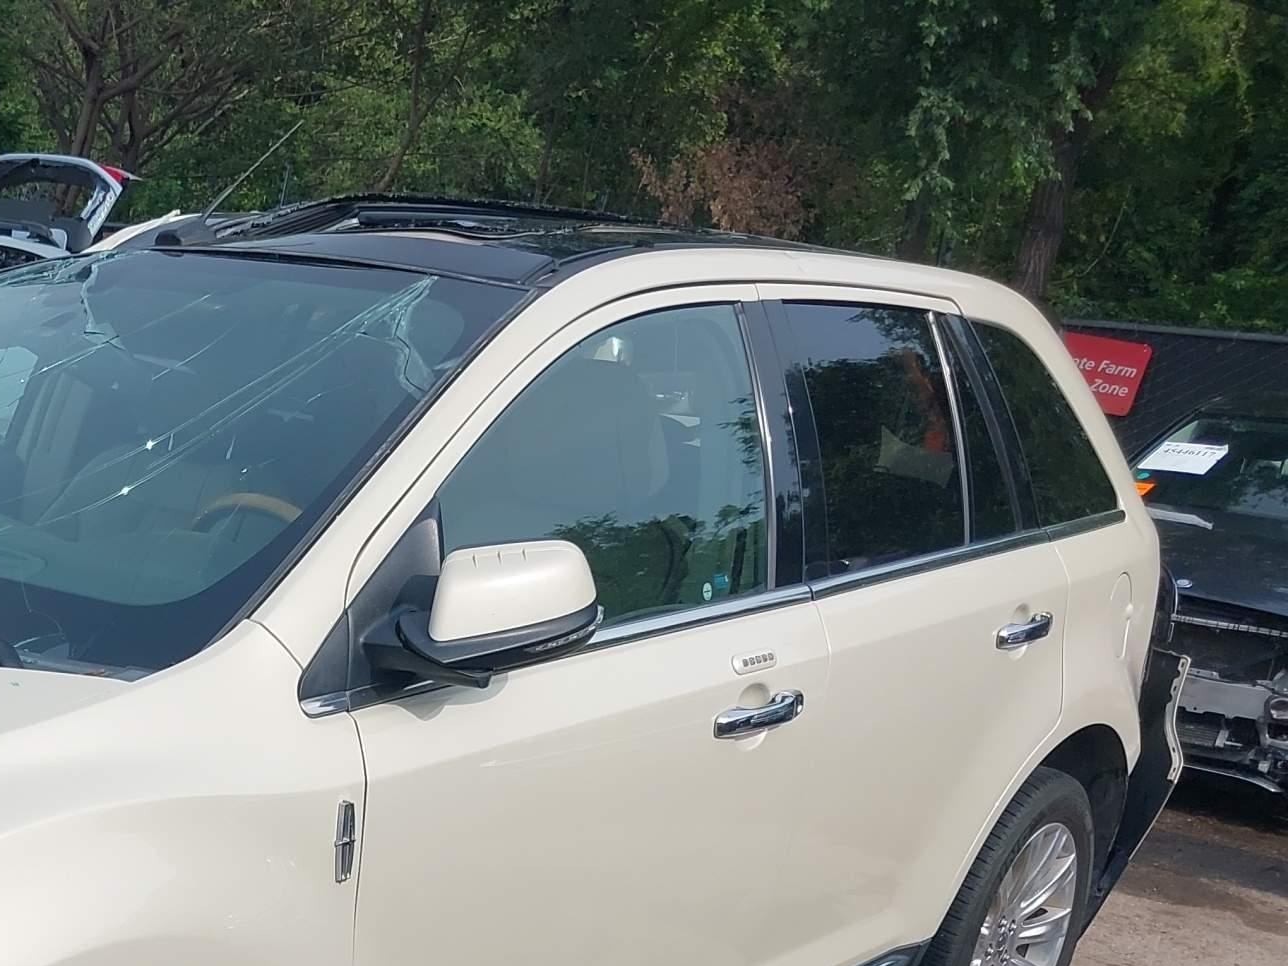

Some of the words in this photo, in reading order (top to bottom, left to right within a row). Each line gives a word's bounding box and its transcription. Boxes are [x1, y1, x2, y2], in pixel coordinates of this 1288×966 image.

[1072, 357, 1095, 371] ate
[1097, 360, 1137, 378] Farm
[1090, 379, 1129, 397] Zone
